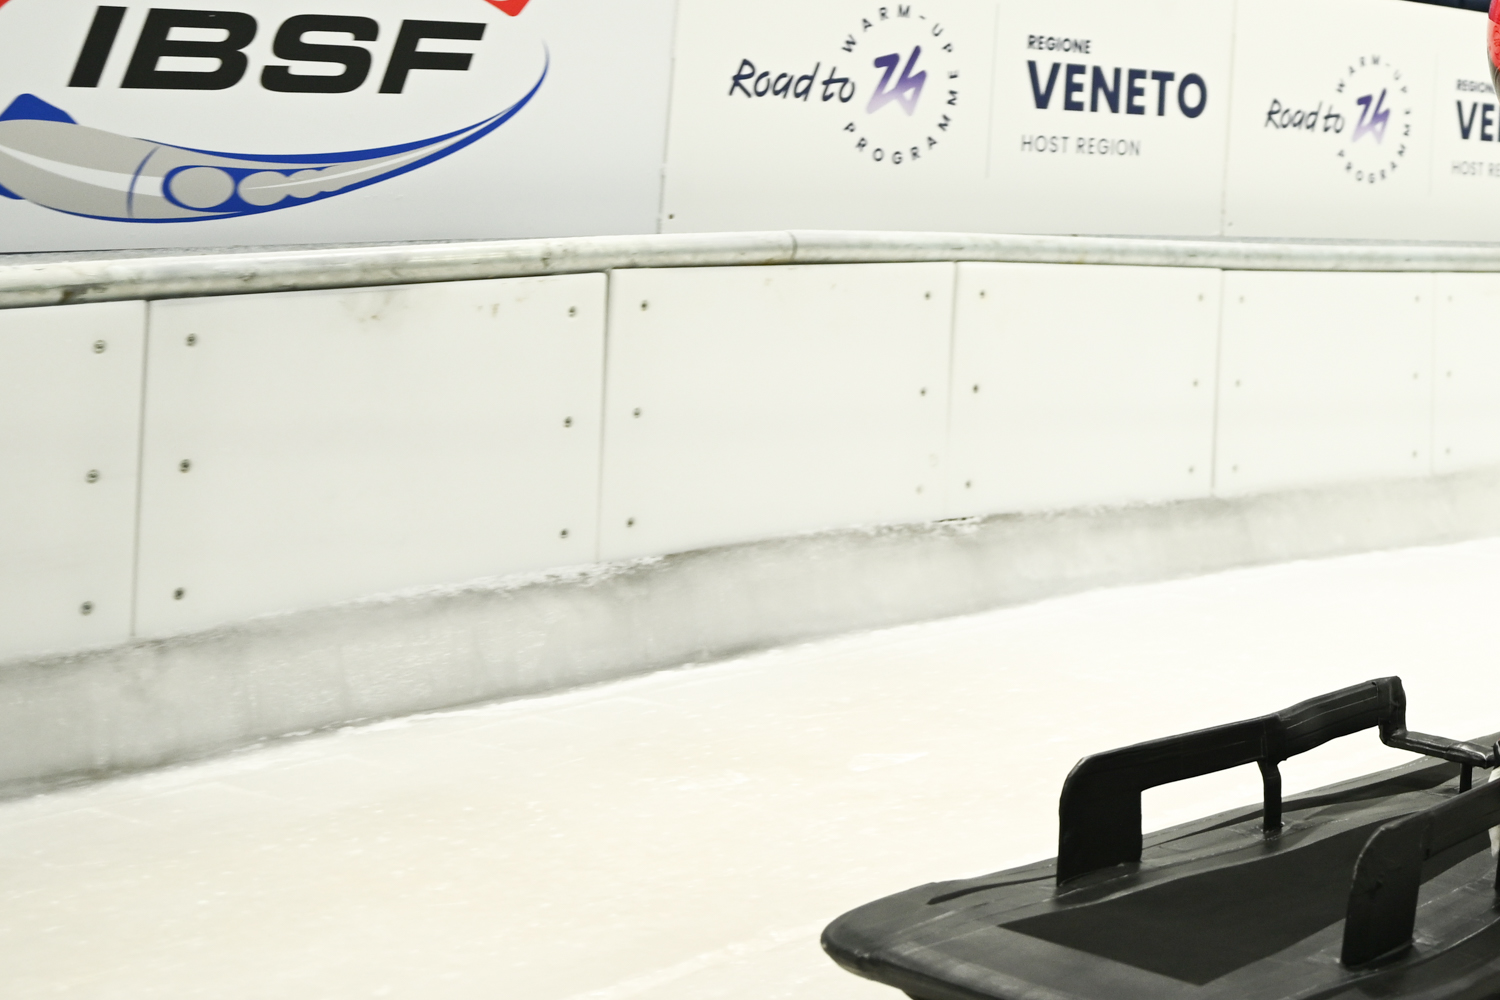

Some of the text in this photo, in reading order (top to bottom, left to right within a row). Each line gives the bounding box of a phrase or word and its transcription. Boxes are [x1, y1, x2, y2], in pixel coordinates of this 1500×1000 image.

[842, 4, 954, 53] WARM-UP
[1027, 34, 1092, 54] REGIONE
[67, 5, 488, 95] IBSF
[728, 58, 821, 101] Road
[822, 66, 856, 103] to
[1027, 60, 1208, 118] VENETO
[1457, 79, 1496, 95] REGION
[844, 70, 960, 165] PROGRAMME
[1264, 98, 1323, 132] Road
[1323, 104, 1345, 133] to
[1020, 135, 1141, 156] HOST REGION
[1451, 161, 1484, 176] HOST
